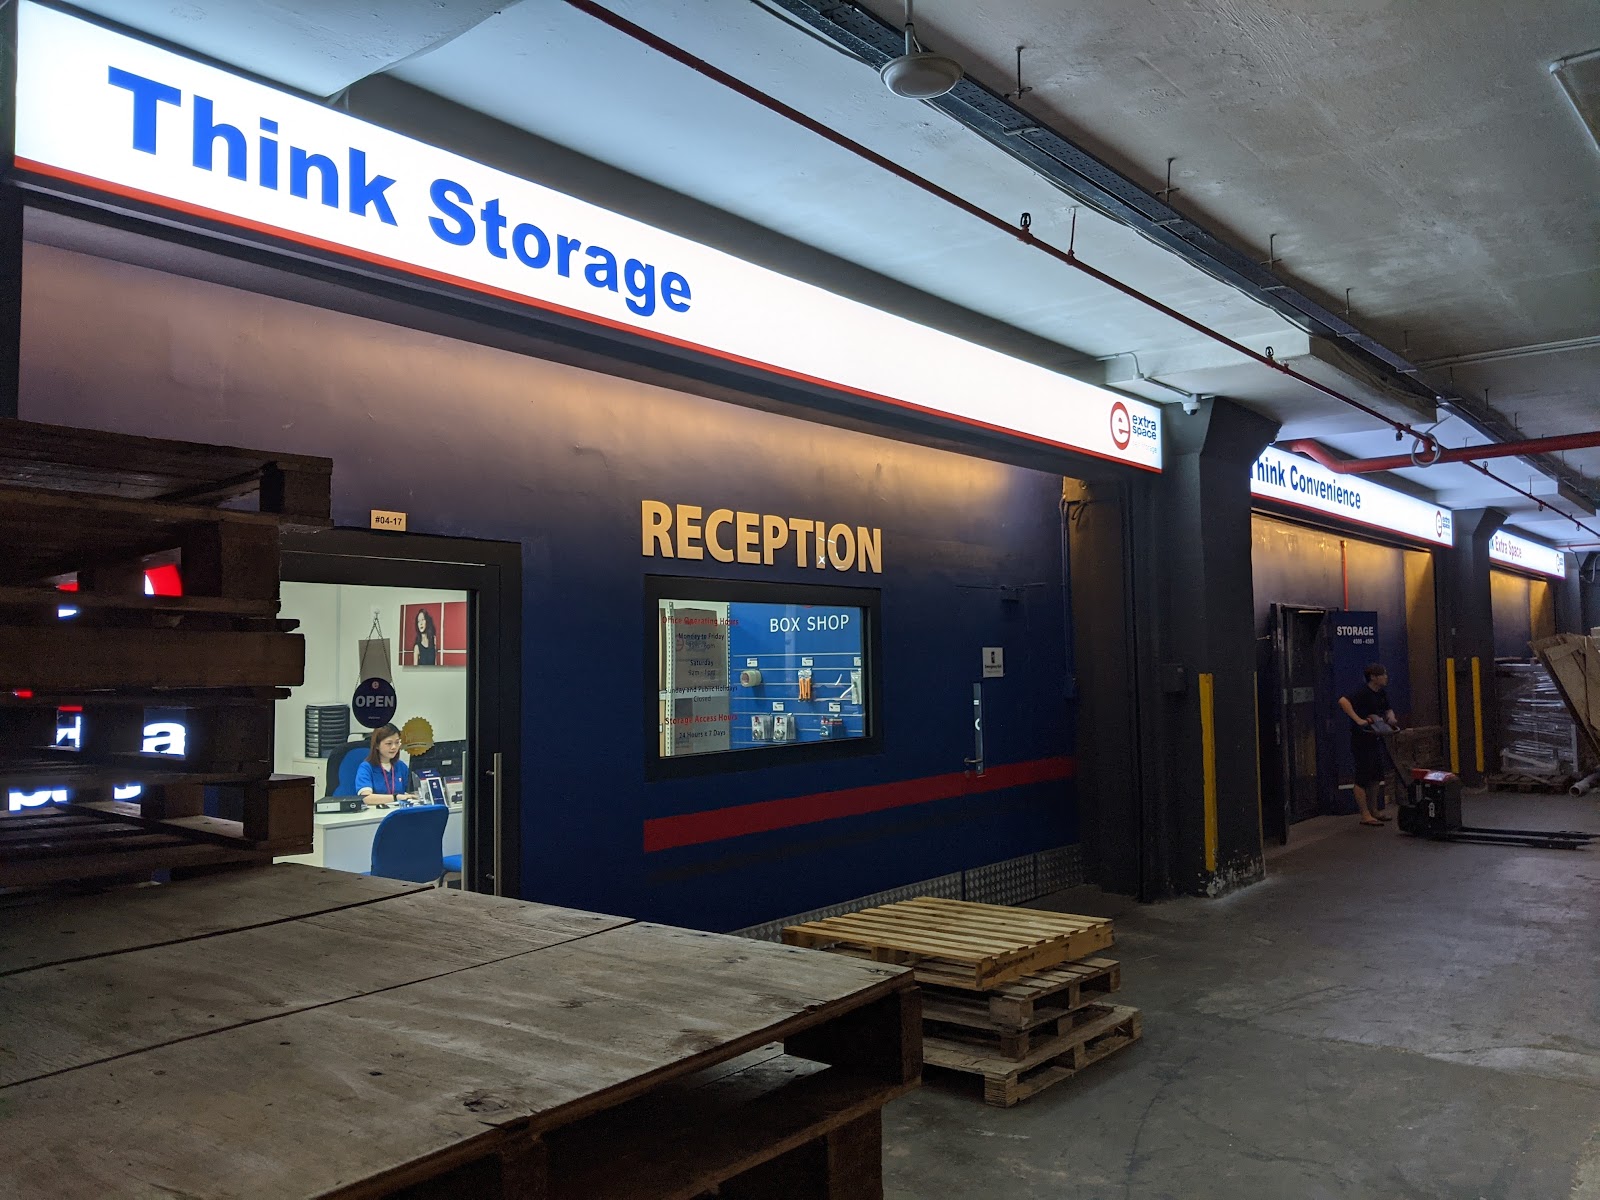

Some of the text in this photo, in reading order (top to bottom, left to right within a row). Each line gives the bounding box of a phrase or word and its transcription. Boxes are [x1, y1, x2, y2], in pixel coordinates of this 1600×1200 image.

[108, 65, 692, 317] Think Storage
[1132, 414, 1157, 431] extra
[1132, 425, 1157, 440] space
[1250, 456, 1361, 510] hink Convenience
[375, 516, 403, 526] #04-17
[641, 500, 882, 573] RECEPTION
[1495, 535, 1508, 554] Extra
[1508, 540, 1522, 561] Space
[662, 616, 739, 627] Office Operating Hours
[770, 614, 849, 633] BOX SHOP
[678, 632, 700, 641] Monday
[708, 632, 725, 641] Friday
[1337, 626, 1374, 636] STORAGE
[690, 659, 714, 667] Saturday
[665, 687, 685, 695] Sunday
[698, 685, 715, 693] Public
[355, 695, 394, 707] OPEN
[693, 695, 712, 703] Closed
[665, 713, 738, 726] Storage Access Hours
[713, 729, 726, 737] Days
